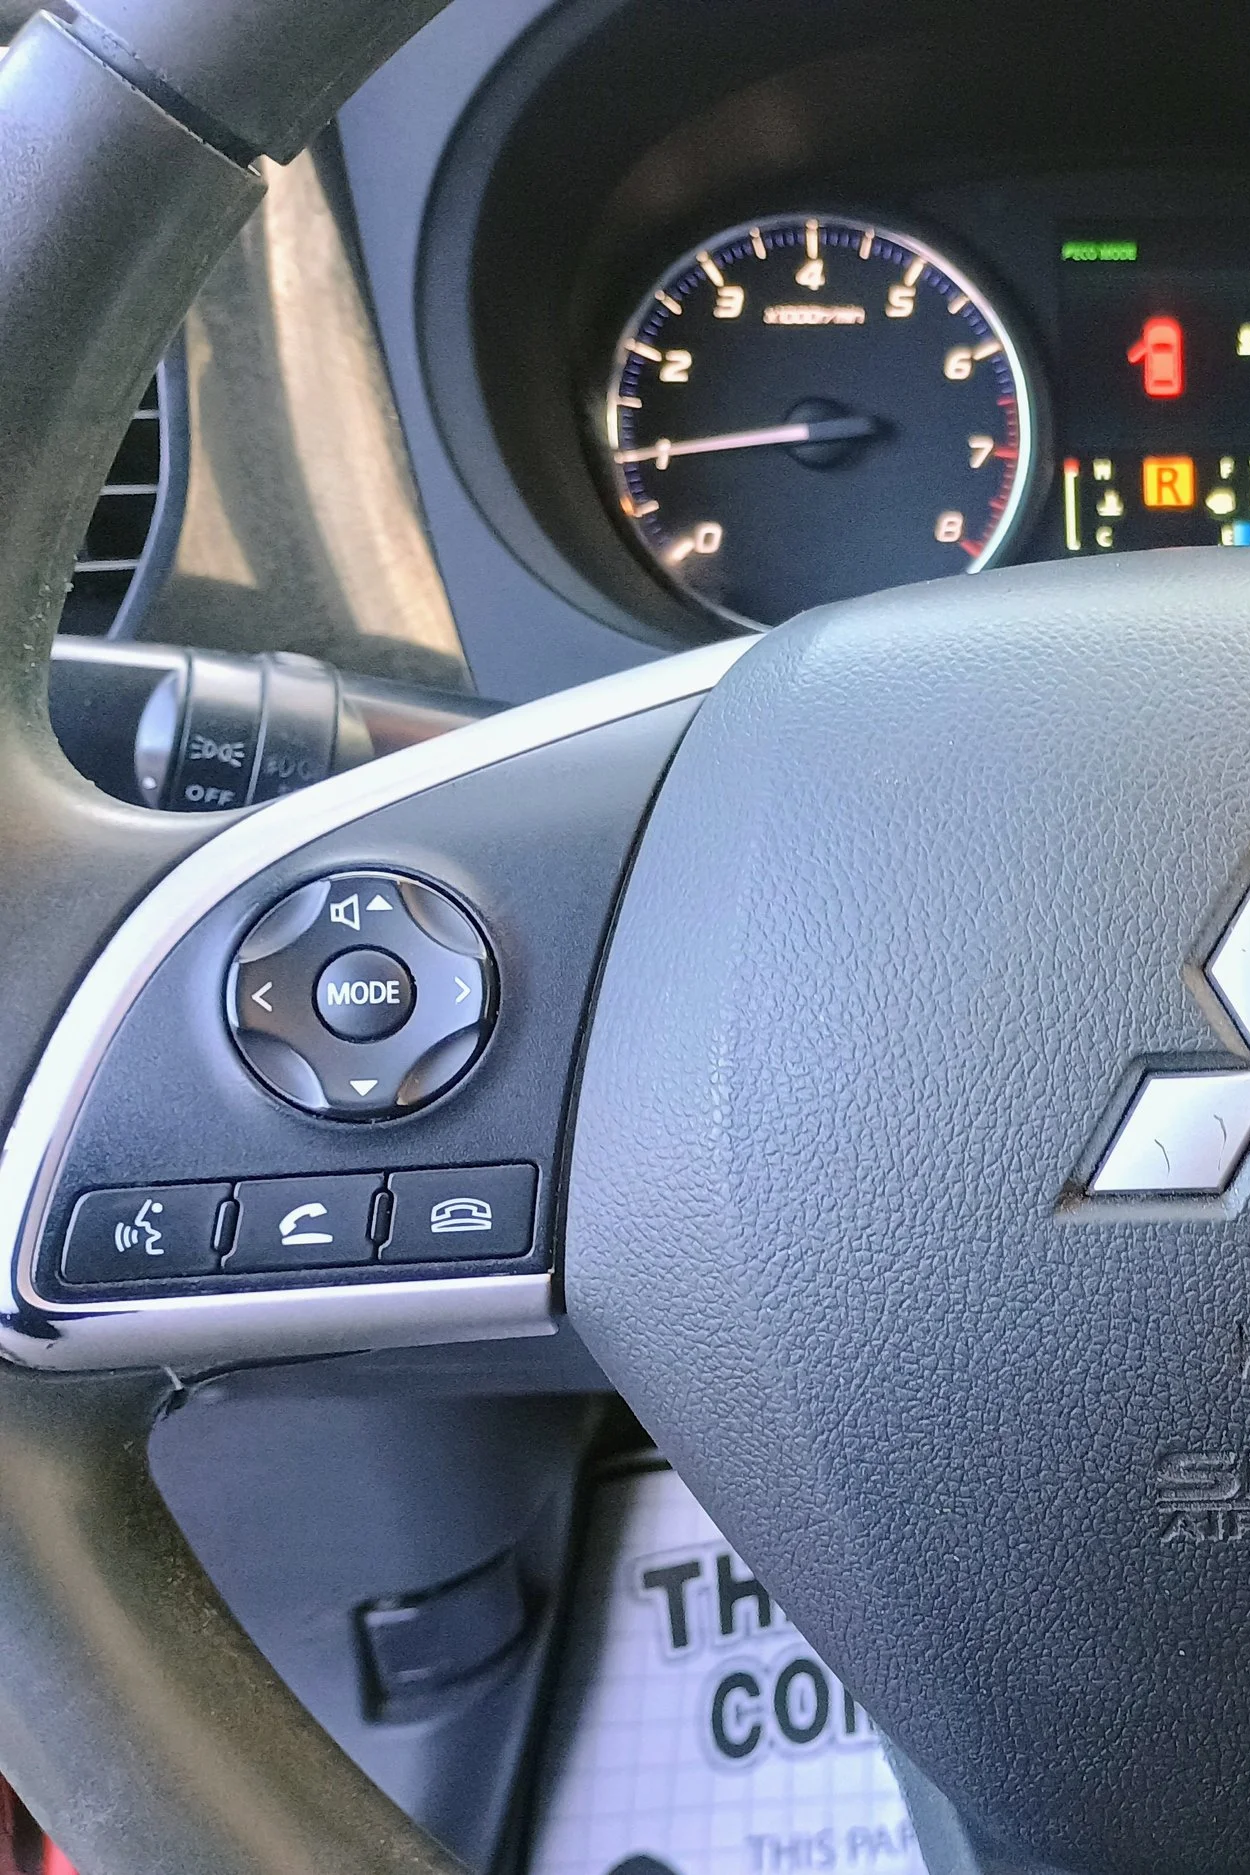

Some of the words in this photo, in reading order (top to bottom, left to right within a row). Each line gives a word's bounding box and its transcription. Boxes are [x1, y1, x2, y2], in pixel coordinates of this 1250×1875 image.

[796, 259, 825, 291] 4
[713, 285, 744, 319] 3
[885, 284, 916, 317] 5
[659, 348, 692, 382] 2
[944, 346, 974, 379] 6
[968, 435, 994, 468] 7
[694, 520, 722, 554] 0
[934, 510, 963, 542] 8
[184, 784, 236, 807] OFF
[327, 980, 401, 1006] MODE
[643, 1554, 792, 1649] TH
[744, 1826, 838, 1873] THIS
